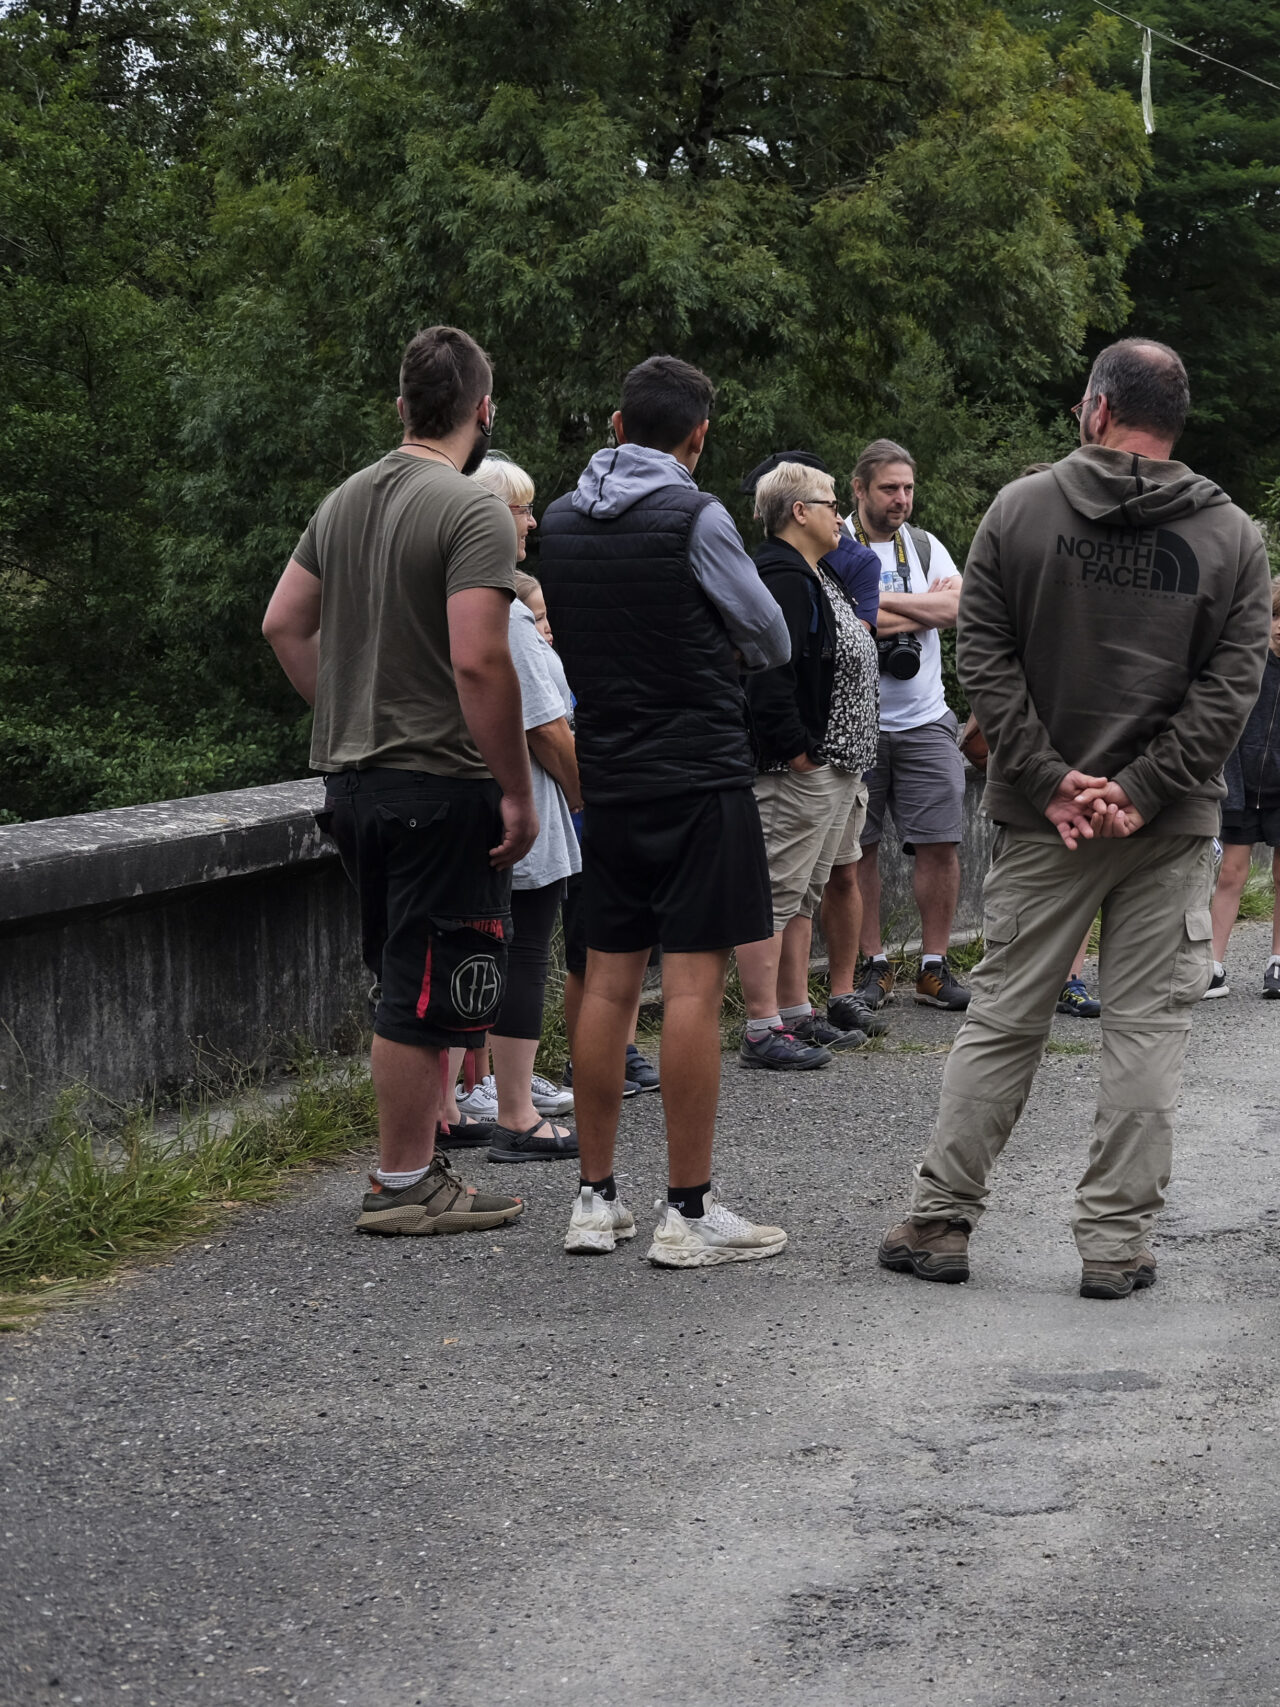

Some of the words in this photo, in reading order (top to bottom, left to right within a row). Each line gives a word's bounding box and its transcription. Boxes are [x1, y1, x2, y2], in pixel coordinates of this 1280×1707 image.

[1056, 534, 1153, 567] NORTH
[1105, 527, 1154, 547] THE
[1082, 561, 1149, 589] FACE
